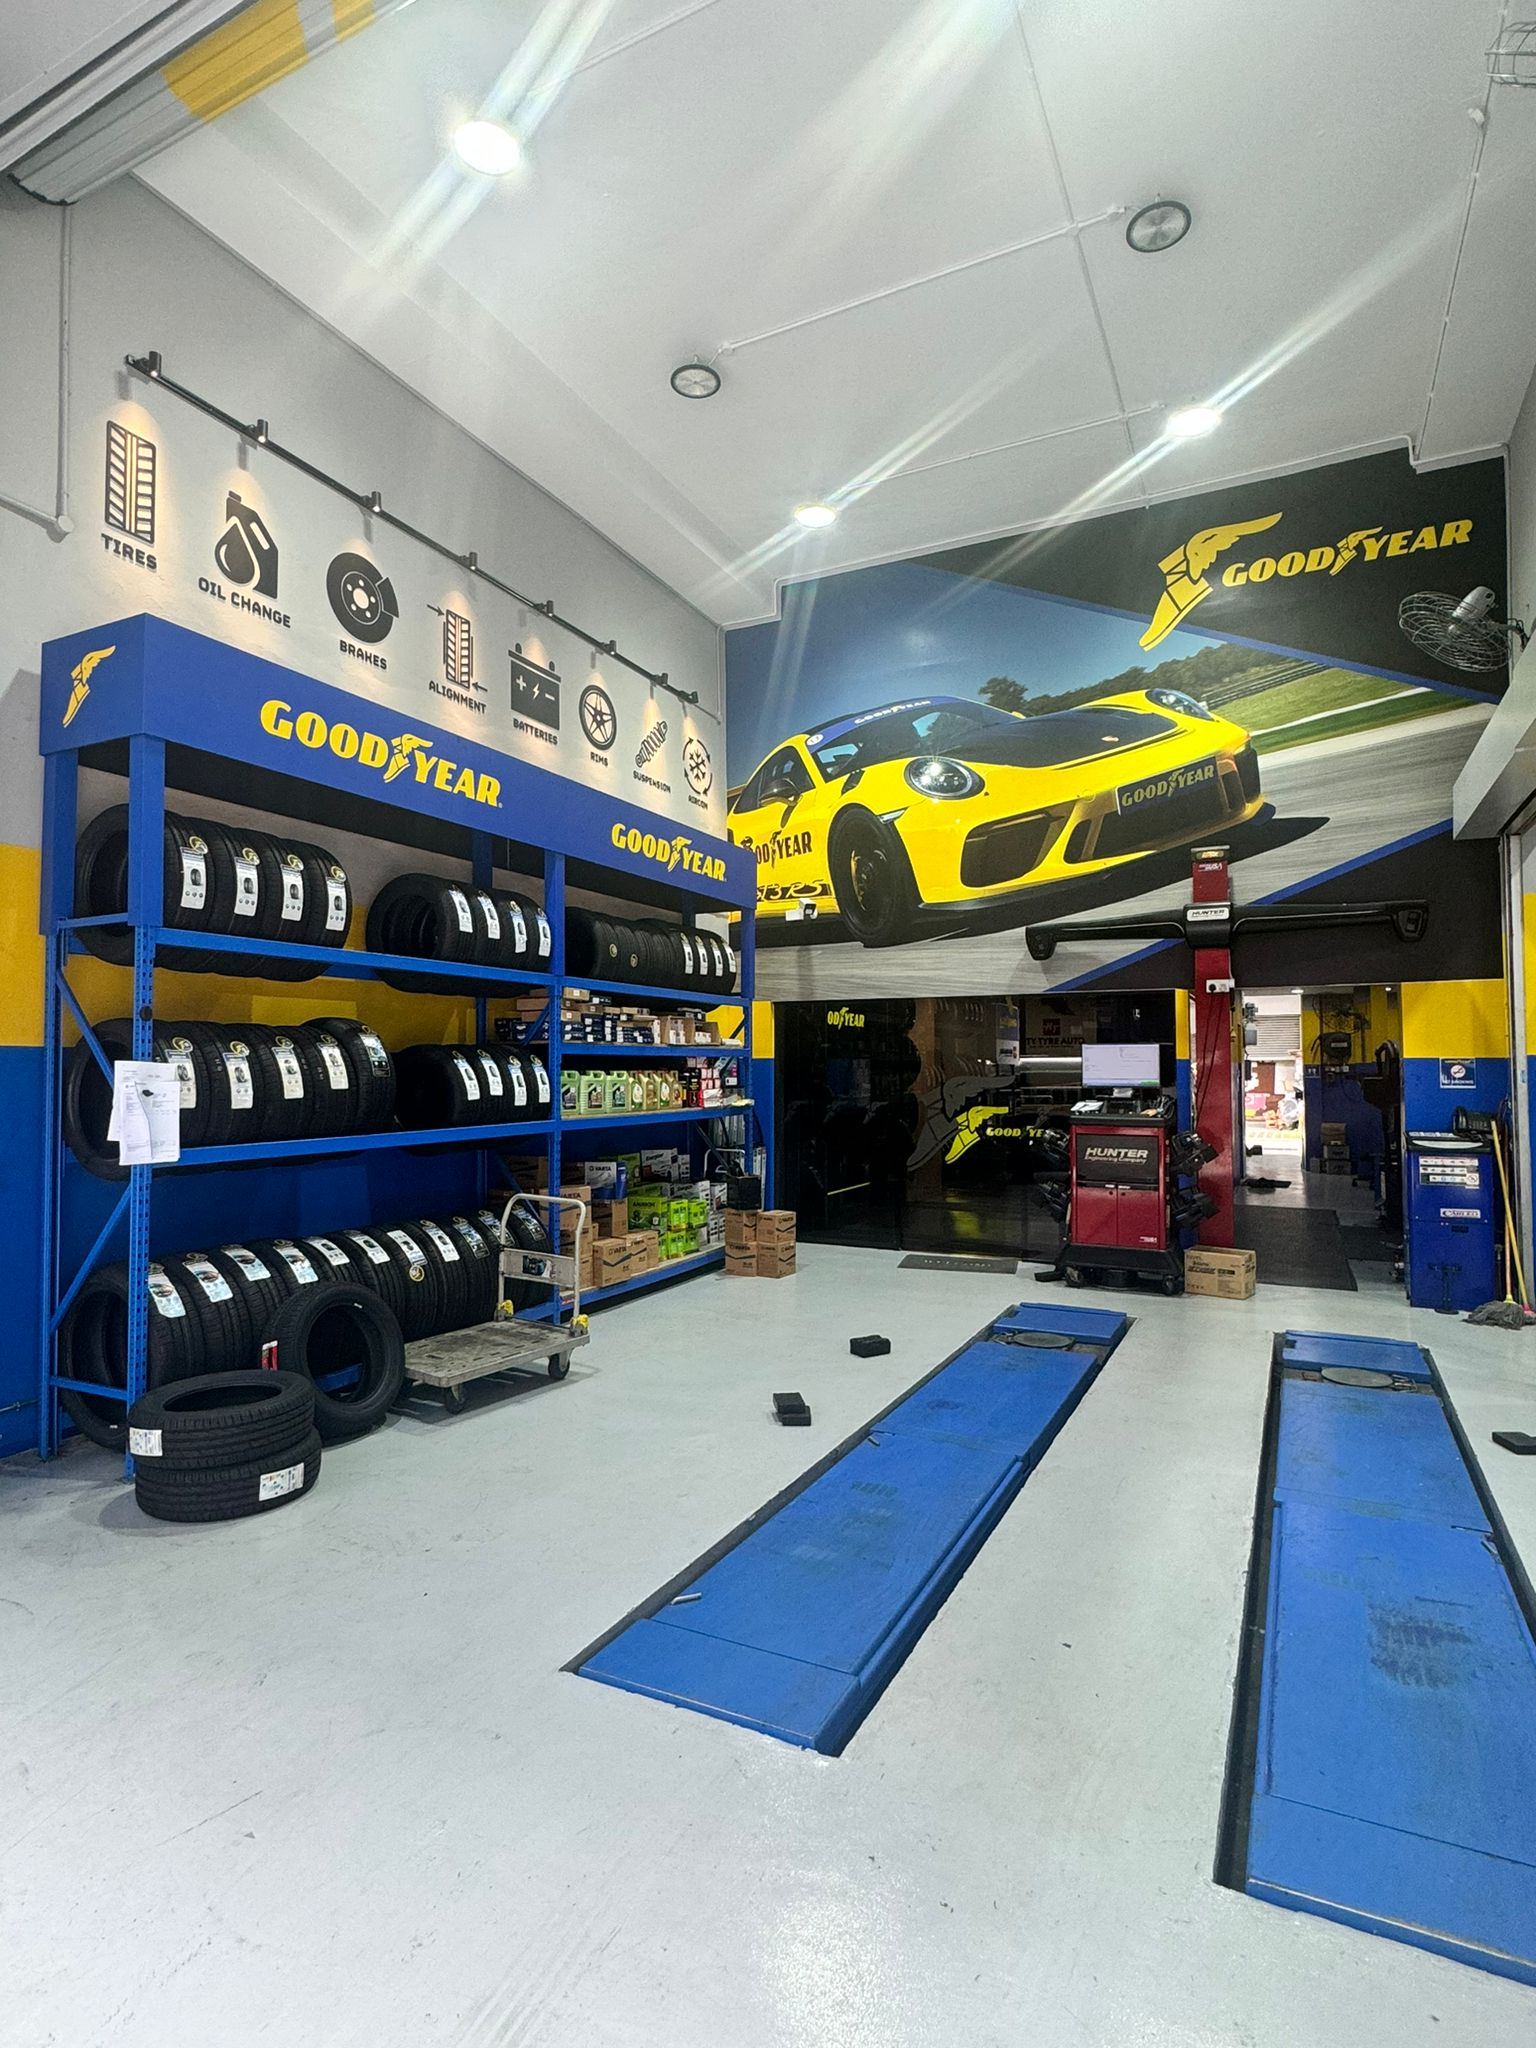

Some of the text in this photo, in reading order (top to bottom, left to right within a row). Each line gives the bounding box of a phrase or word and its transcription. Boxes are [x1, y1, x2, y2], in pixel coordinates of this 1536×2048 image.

[101, 533, 157, 570] TIRES
[1222, 519, 1473, 588] GOODYEAR
[198, 577, 291, 628] OIL CHANGE
[339, 640, 387, 670] BRAKES
[429, 680, 487, 714] ALIGNMENT
[513, 718, 558, 746] BATTERIES
[260, 699, 502, 808] GOODYEAR
[590, 752, 609, 767] RIMS
[633, 770, 672, 794] SUSPENSION
[1121, 764, 1214, 807] GOODYEAR
[688, 794, 708, 810] AIRCON
[611, 823, 727, 882] GOODYEAR
[756, 829, 812, 868] ODYEAR
[1192, 908, 1225, 917] HUNTER
[1061, 1037, 1085, 1045] AUTO
[1085, 1147, 1149, 1159] HUNTER
